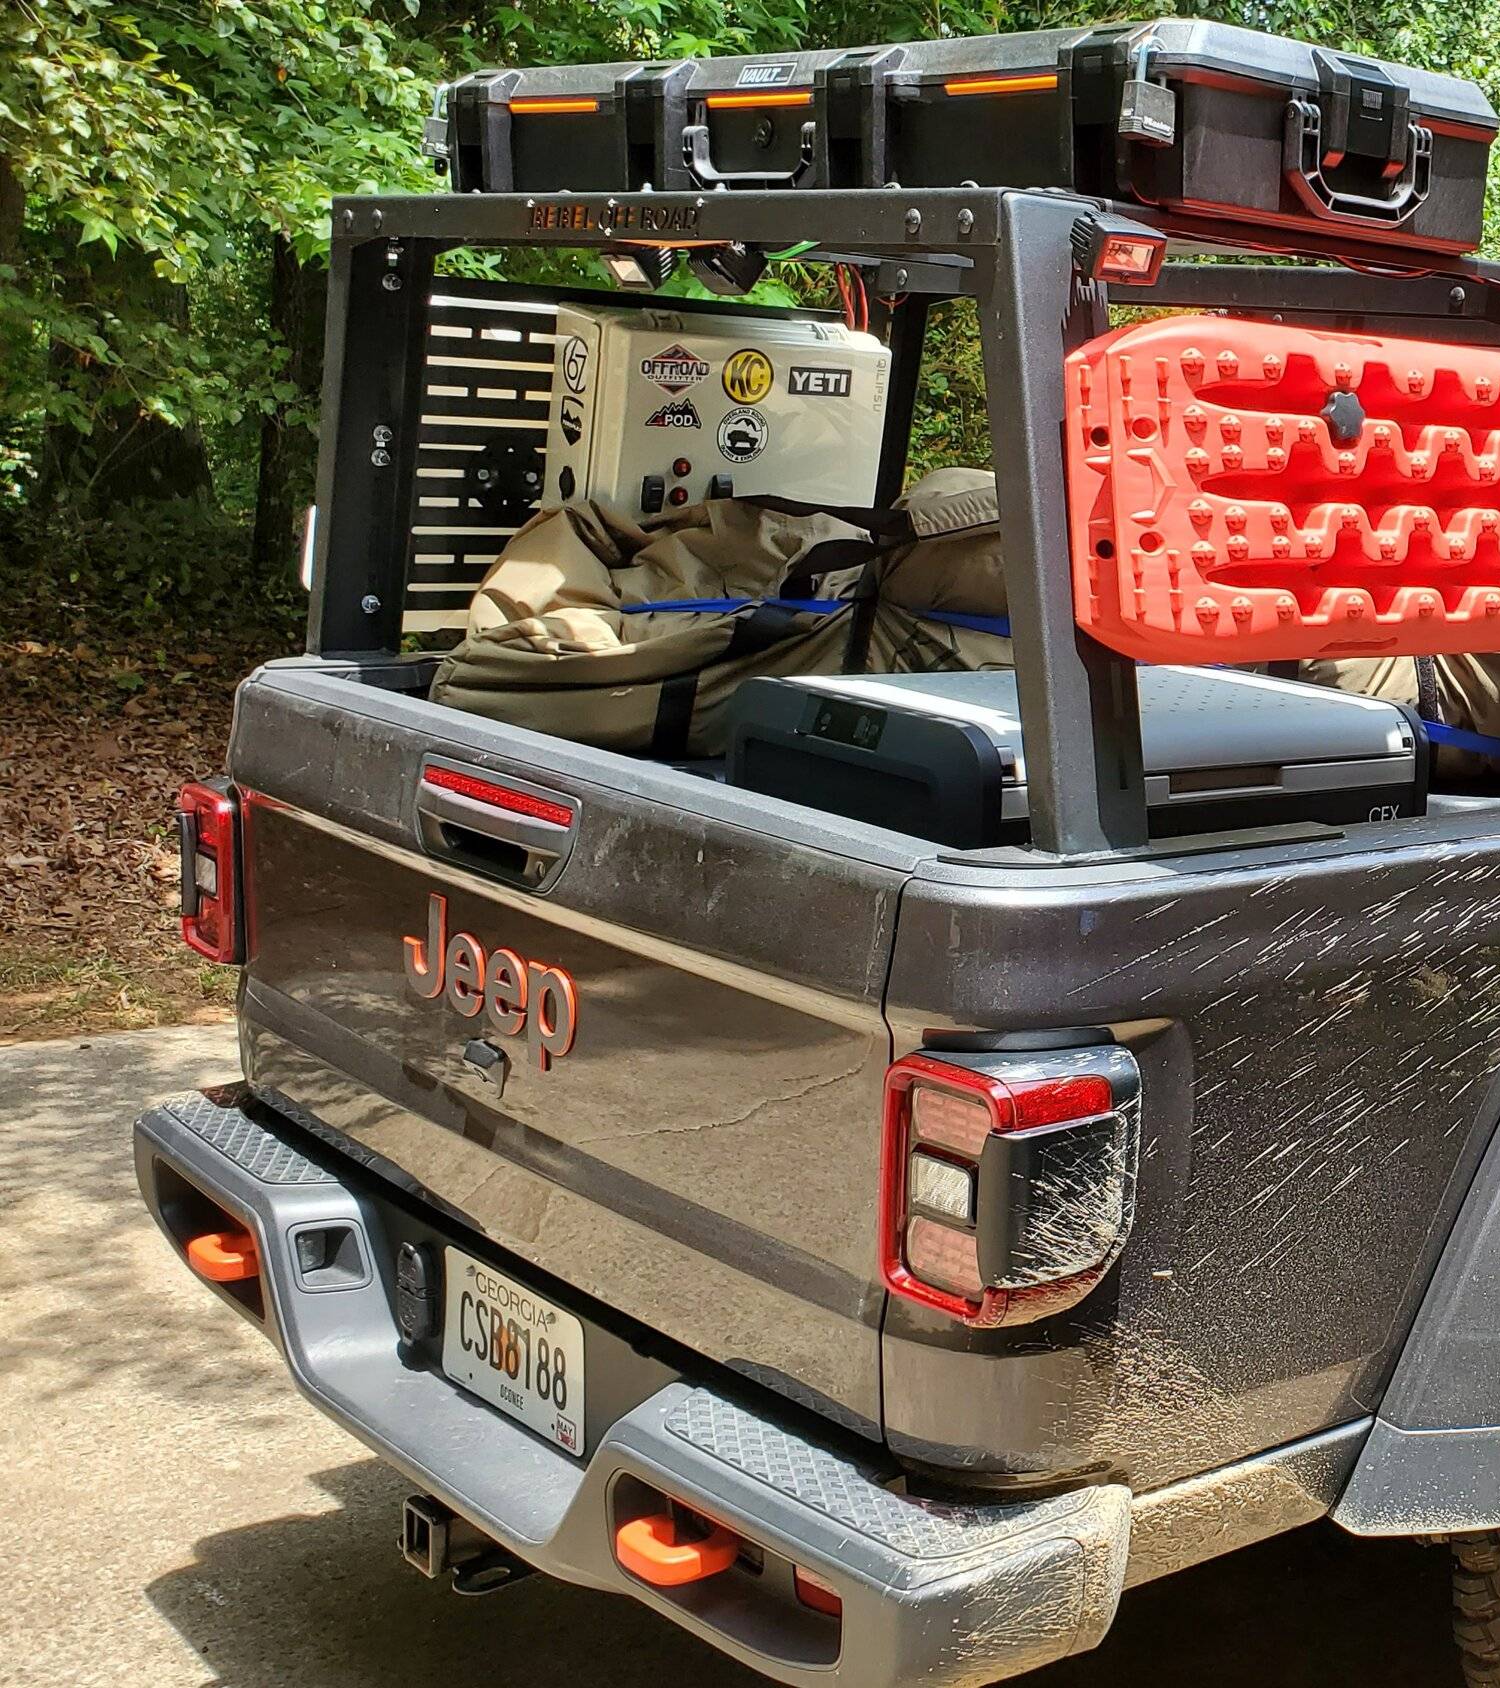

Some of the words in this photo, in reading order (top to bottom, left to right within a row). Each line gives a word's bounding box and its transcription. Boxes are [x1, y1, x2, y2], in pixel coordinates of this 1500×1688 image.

[741, 67, 782, 83] VAULT
[531, 205, 595, 231] REBEL
[599, 205, 637, 231] OFF
[640, 205, 698, 231] ROAD
[641, 359, 710, 376] OFFROAD
[730, 354, 768, 398] KC
[792, 370, 848, 393] YETI
[664, 414, 694, 427] POD
[402, 891, 577, 1073] Jeep
[475, 1271, 549, 1333] GEORGIA
[460, 1290, 568, 1411] CSB8188
